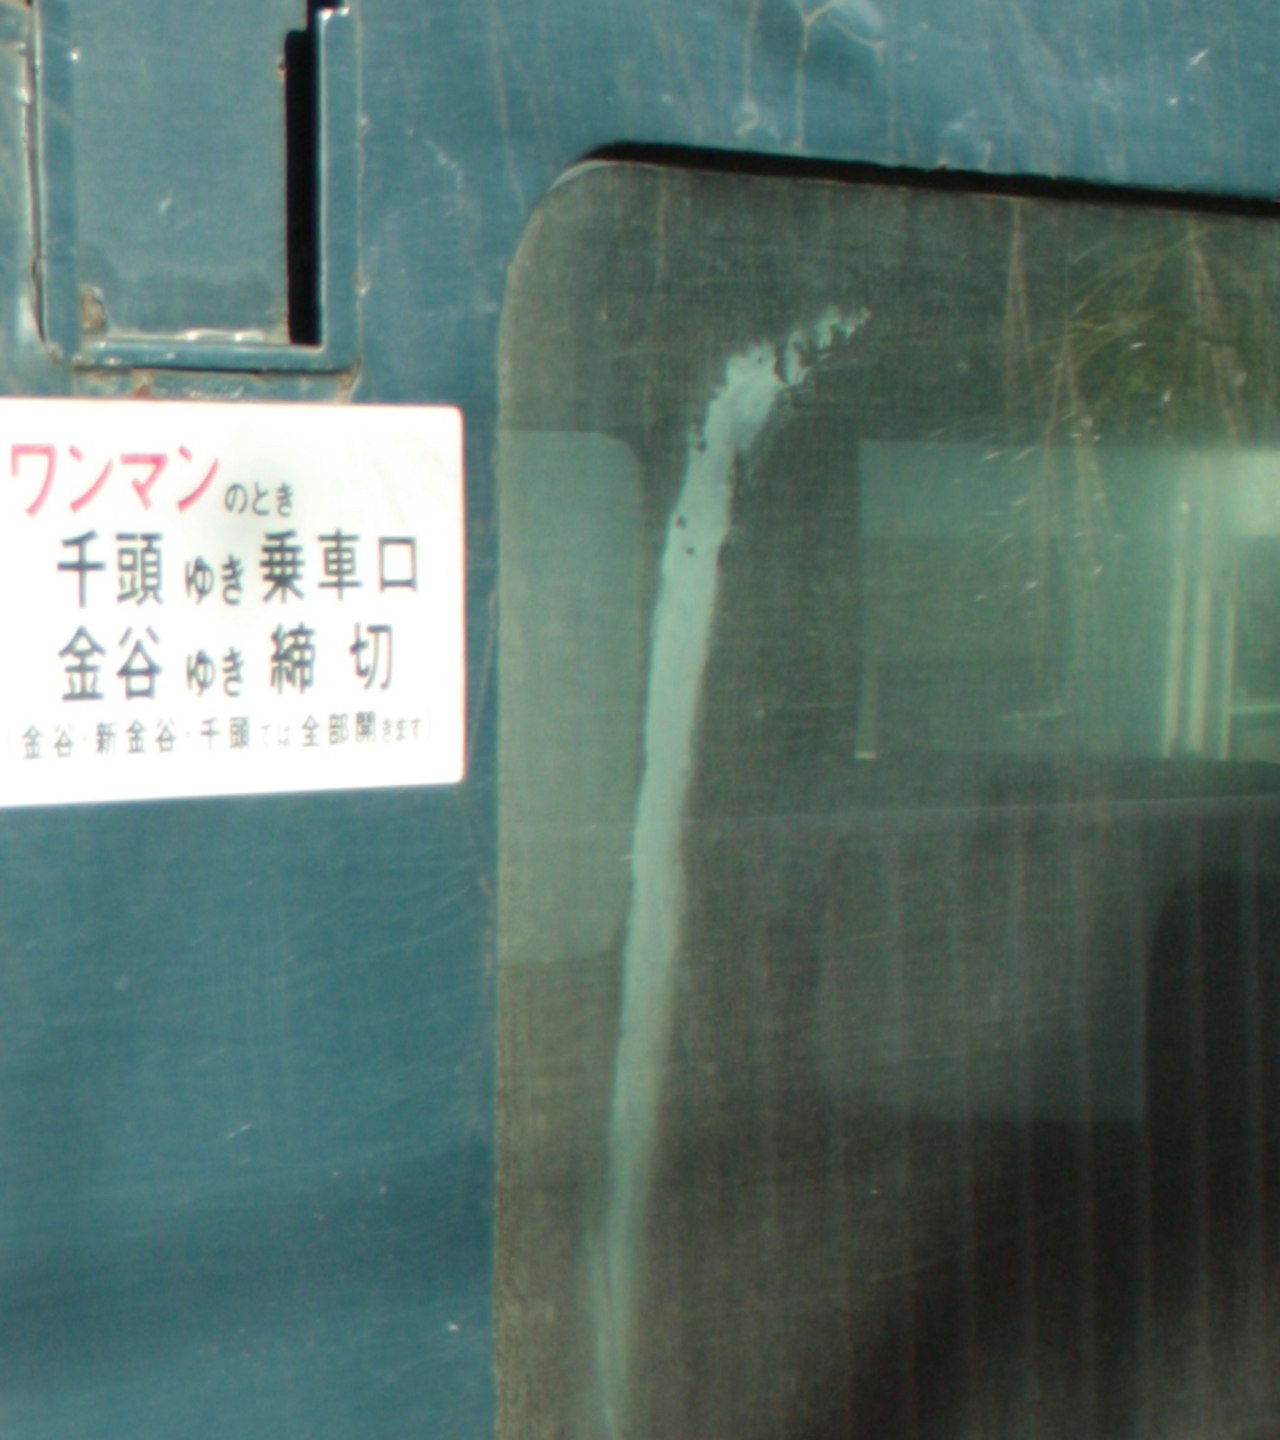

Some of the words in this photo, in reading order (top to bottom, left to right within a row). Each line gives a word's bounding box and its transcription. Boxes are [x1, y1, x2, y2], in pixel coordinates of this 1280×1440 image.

[10, 444, 295, 518] ワンマンのとき
[57, 527, 418, 608] 千頭ゆき乗車口
